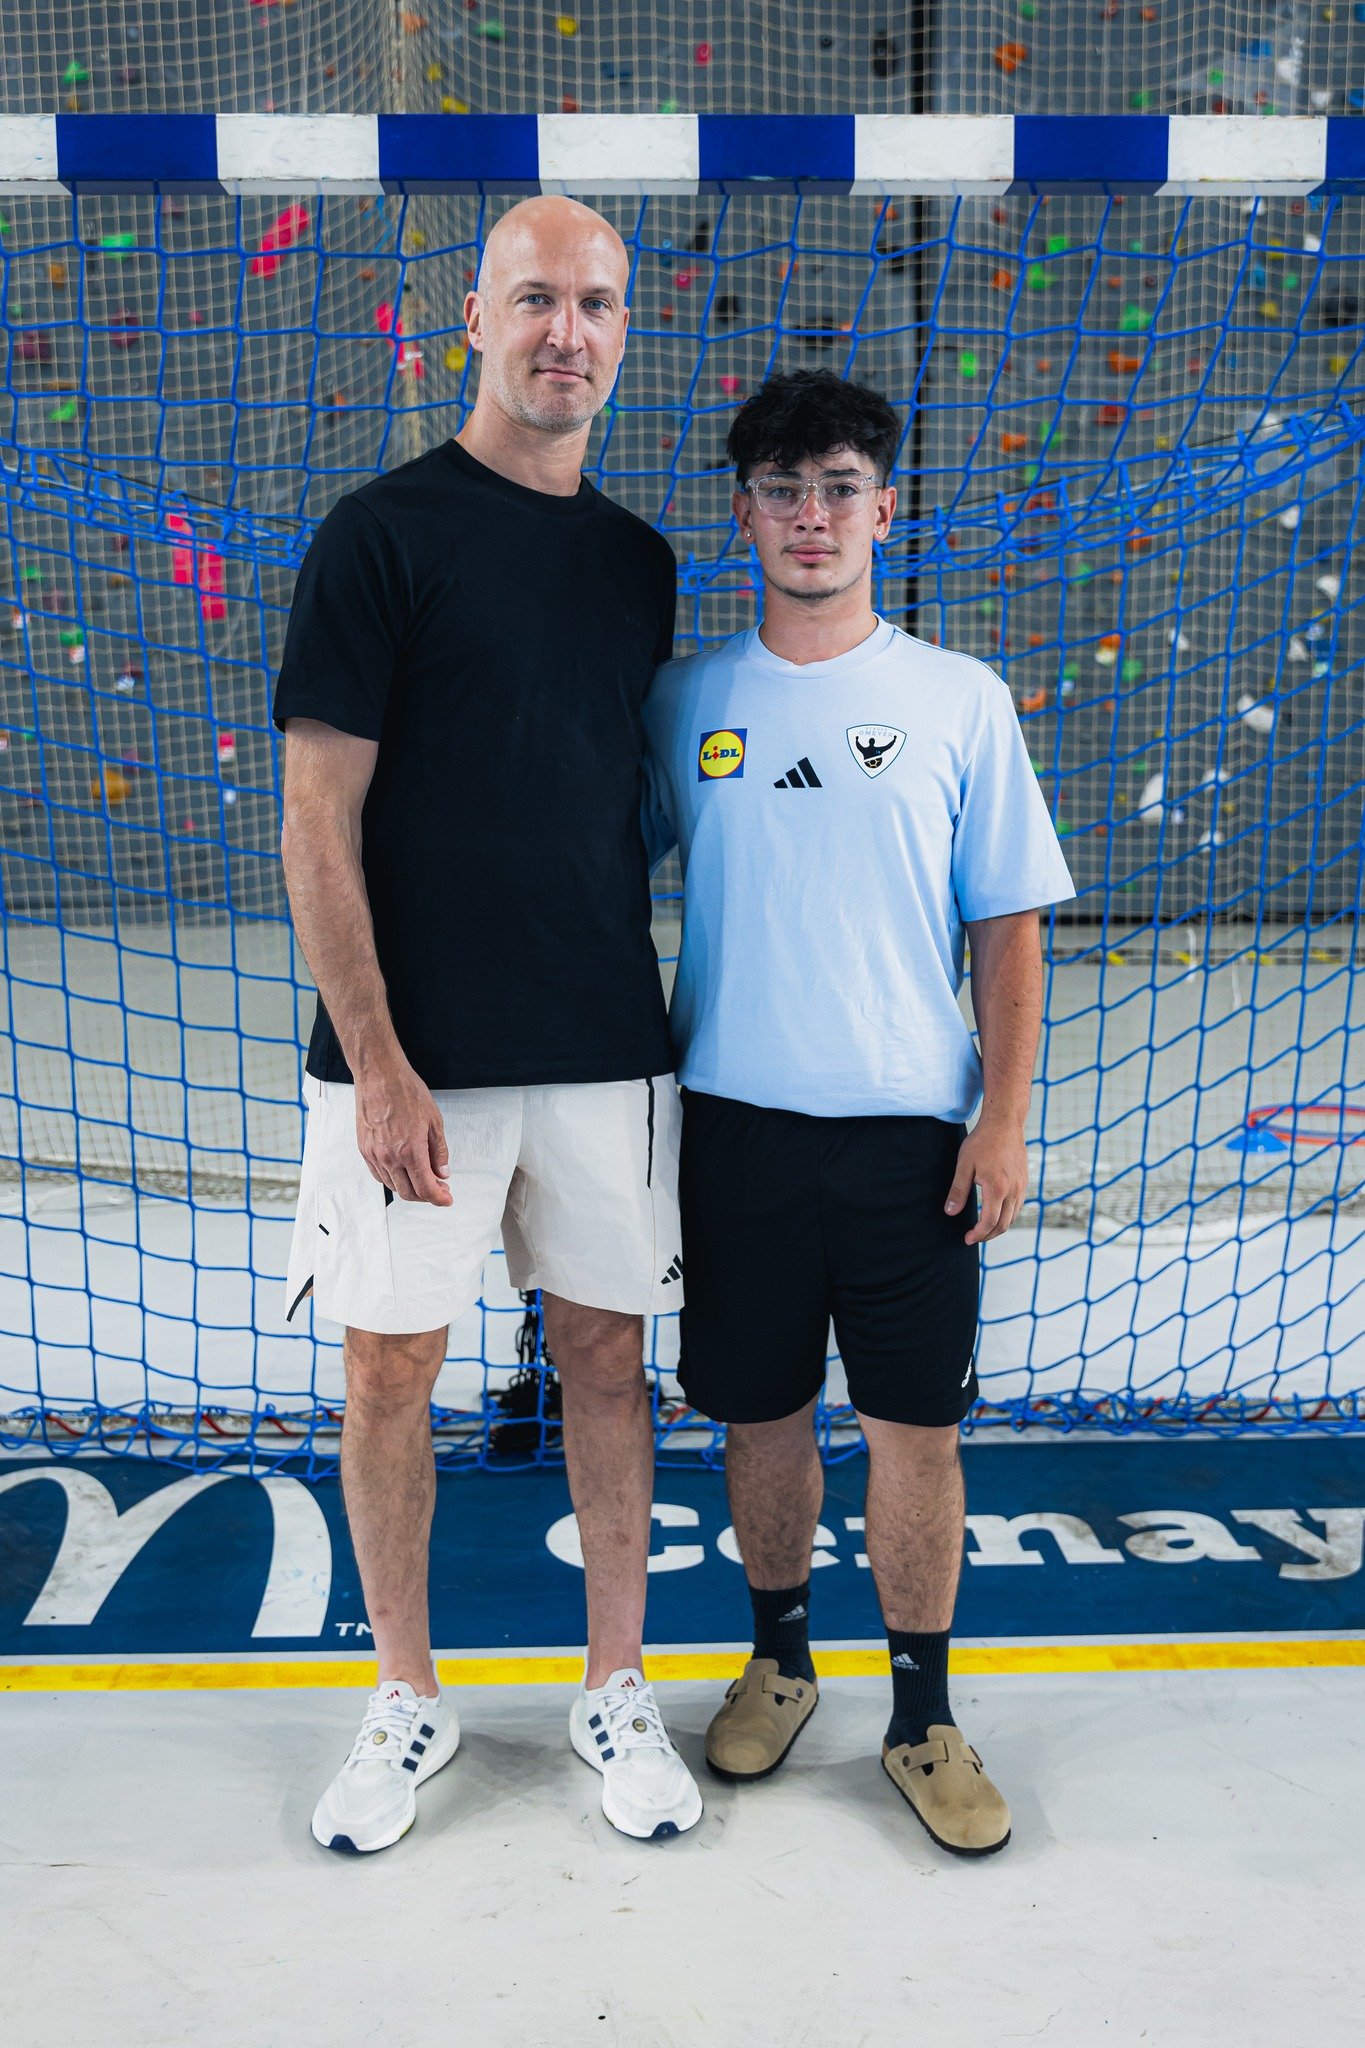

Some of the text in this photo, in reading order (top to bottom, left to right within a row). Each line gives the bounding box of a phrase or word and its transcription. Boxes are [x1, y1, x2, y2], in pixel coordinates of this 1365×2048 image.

[859, 730, 893, 738] OMEYER
[702, 745, 740, 762] LIDL
[545, 1502, 1365, 1581] Cnay
